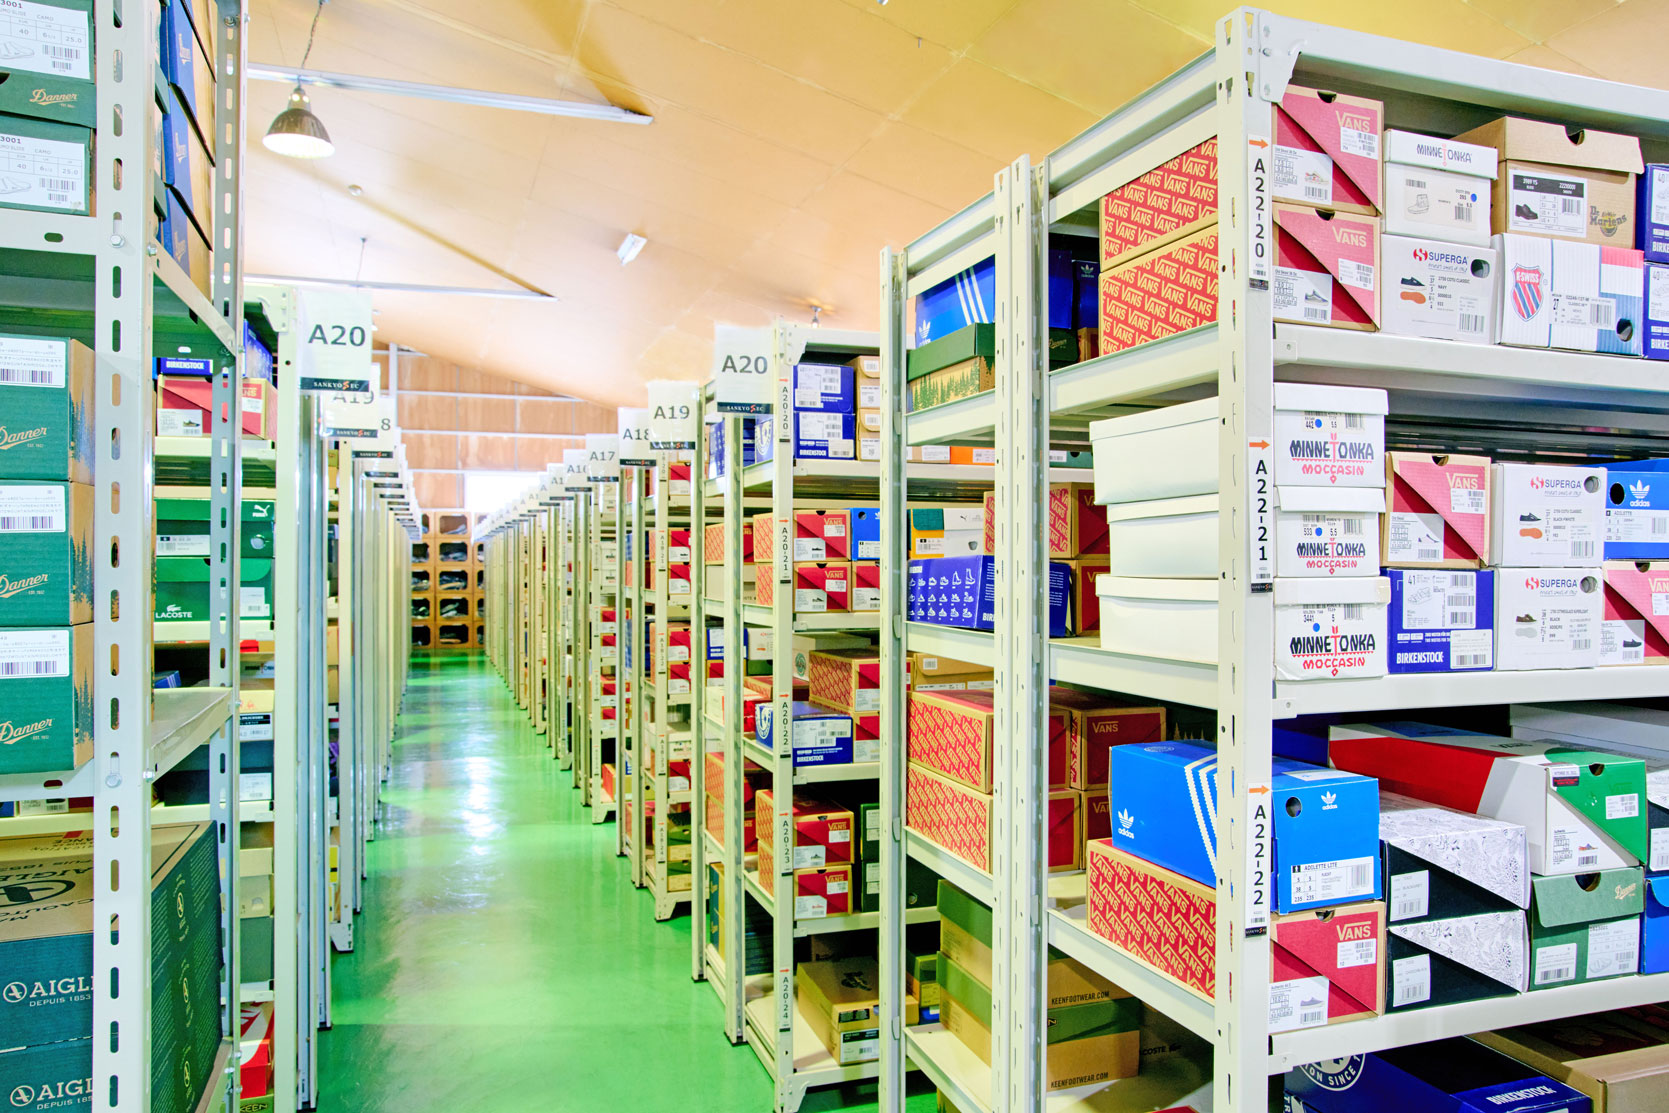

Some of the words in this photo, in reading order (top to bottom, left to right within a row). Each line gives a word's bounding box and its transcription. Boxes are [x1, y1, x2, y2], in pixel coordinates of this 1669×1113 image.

[29, 88, 78, 105] Danner
[1336, 110, 1370, 132] VANS
[1416, 144, 1472, 164] MINNETONKA
[1182, 156, 1208, 177] VANS
[1124, 184, 1146, 203] VANS
[1164, 173, 1189, 194] VANS
[1190, 179, 1216, 201] VANS
[1108, 198, 1130, 218] VANS
[1147, 189, 1171, 210] VANS
[1172, 196, 1197, 218] VANS
[1254, 158, 1266, 258] A22-20
[1131, 205, 1154, 226] VANS
[1590, 214, 1627, 226] Martens
[1116, 220, 1137, 241] VANS
[1332, 226, 1367, 248] VANS
[1154, 258, 1178, 280] VANS
[1429, 252, 1468, 265] SUPERGA
[1137, 271, 1160, 294] VANS
[1179, 266, 1206, 290] VANS
[1516, 272, 1540, 283] K-SWISS
[1122, 285, 1144, 308] VANS
[1162, 281, 1186, 305] VANS
[1106, 298, 1127, 320] VANS
[1144, 295, 1168, 318] VANS
[1187, 292, 1215, 317] VANS
[1128, 308, 1151, 331] VANS
[1169, 306, 1195, 329] VANS
[308, 324, 366, 346] A20
[1113, 321, 1134, 344] VANS
[722, 355, 768, 374] A20
[654, 406, 690, 420] A19
[590, 452, 616, 461] A17
[1290, 440, 1374, 462] MINNETONKA
[1302, 464, 1364, 476] MOCCASIN
[1446, 472, 1478, 489] VANS
[1545, 479, 1581, 488] SUPERGA
[1256, 460, 1268, 561] A22-21
[1304, 528, 1312, 536] 533
[1296, 542, 1366, 558] MINNETONKA
[825, 570, 844, 578] VANS
[1306, 560, 1358, 569] MOCCASIN
[1540, 579, 1578, 588] SUPERGA
[1648, 578, 1669, 593] VAN
[1290, 634, 1376, 656] MINNETONKA
[1302, 657, 1366, 670] MOCCASIN
[1396, 651, 1444, 664] BIRKENSTOCK
[0, 719, 52, 744] Danner
[1092, 720, 1119, 734] VANS
[828, 822, 847, 831] VANS
[1118, 826, 1135, 840] adidas
[1253, 804, 1266, 905] A22-22
[1092, 853, 1114, 882] VANS
[825, 874, 844, 883] VANS
[1100, 876, 1120, 912] VANS
[1115, 876, 1136, 912] VANS
[1130, 876, 1153, 912] VANS
[1146, 875, 1171, 913] VANS
[1092, 904, 1112, 938] VANS
[1106, 904, 1127, 940] VANS
[1121, 904, 1143, 942] VANS
[1137, 905, 1160, 943] VANS
[1154, 905, 1178, 944] VANS
[1172, 906, 1197, 946] VANS
[1190, 906, 1216, 947] VANS
[1336, 921, 1371, 941] VANS
[1161, 936, 1186, 976] VANS
[1179, 937, 1205, 978] VANS
[30, 976, 94, 998] AIGL
[1052, 990, 1110, 1005] KEENFOOTWEAR.COM
[30, 997, 65, 1006] DEPUIS
[1143, 1046, 1166, 1056] COSTE
[1051, 1072, 1108, 1088] KEENFOOTWEAR.COM
[1328, 1065, 1356, 1086] SINCE
[37, 1078, 92, 1100] AIGL
[1486, 1085, 1557, 1105] BIRKENSTOCK
[36, 1100, 72, 1110] DEPUIS
